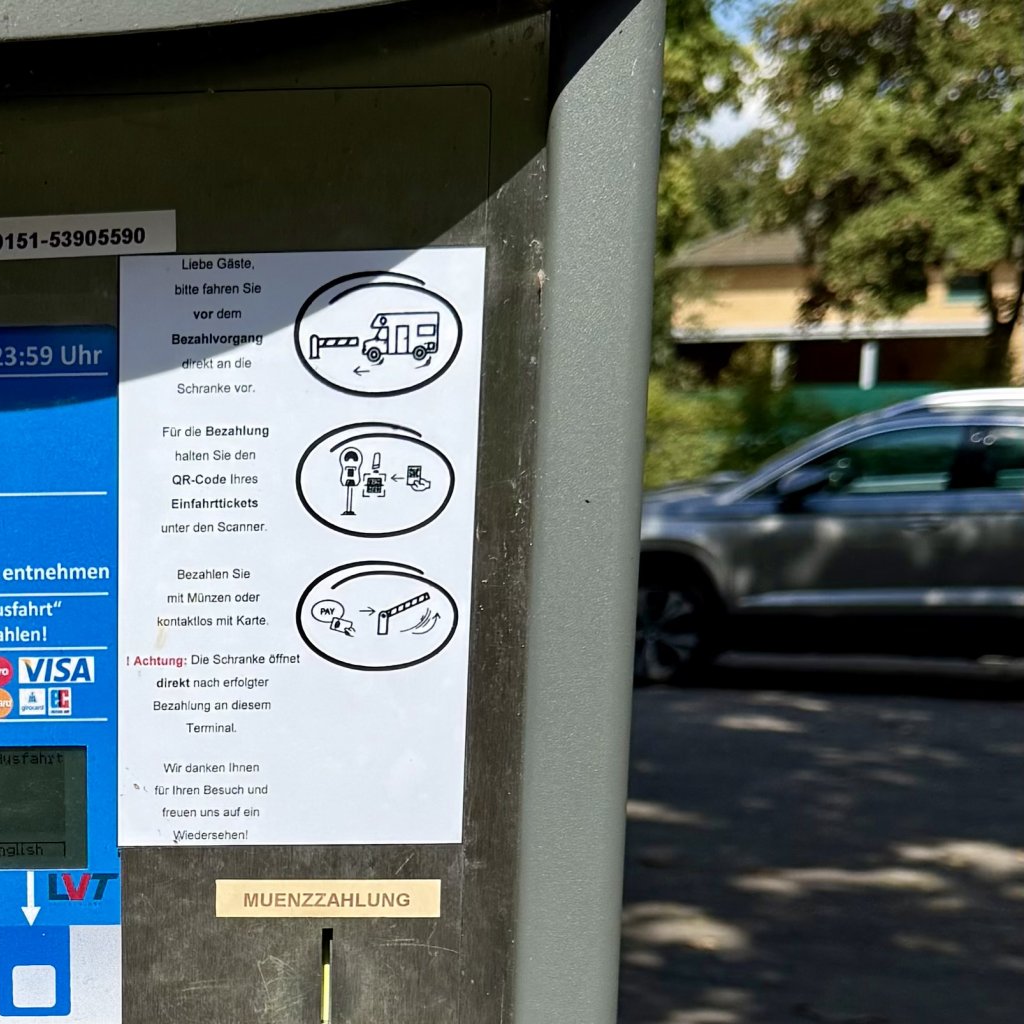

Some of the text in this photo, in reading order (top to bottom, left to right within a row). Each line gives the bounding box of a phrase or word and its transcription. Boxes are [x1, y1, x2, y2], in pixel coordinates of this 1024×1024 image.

[182, 258, 254, 271] Liebe Gäste,
[175, 283, 261, 295] bitte fahren Sie
[193, 308, 242, 320] vor dem
[171, 333, 263, 346] Bezahlvorgang
[61, 345, 102, 366] Uhr
[182, 358, 251, 369] direkt an die
[177, 383, 255, 394] Schranke vor.
[162, 426, 269, 438] Für die Bezahlung
[175, 450, 256, 461] halten Sie den
[172, 474, 258, 485] QR-Code Ihres
[171, 498, 258, 508] Einfahrttickets
[161, 522, 267, 533] unter den Scanner.
[3, 563, 110, 581] entnehmen
[177, 569, 250, 579] Bezahlen Sie
[167, 592, 260, 603] mit Münzen oder
[157, 615, 269, 626] kontaktlos mit Karte.
[134, 655, 187, 668] Achtung:
[191, 655, 209, 665] Die
[213, 654, 265, 664] Schranke
[269, 654, 300, 664] öffnet
[21, 658, 91, 682] VISA
[156, 677, 269, 688] direkt nach erfolgter
[153, 700, 211, 713] Bezahlung
[231, 700, 271, 710] diesem
[186, 723, 237, 733] Terminal.
[164, 763, 259, 773] Wir danken Ihnen
[154, 785, 268, 795] für Ihren Besuch und
[162, 807, 197, 817] freuen
[224, 807, 240, 817] auf
[243, 807, 260, 816] ein
[173, 830, 248, 840] Wiedersehen!
[48, 873, 119, 900] LVT
[243, 893, 410, 908] MUENZZAHLUNG
